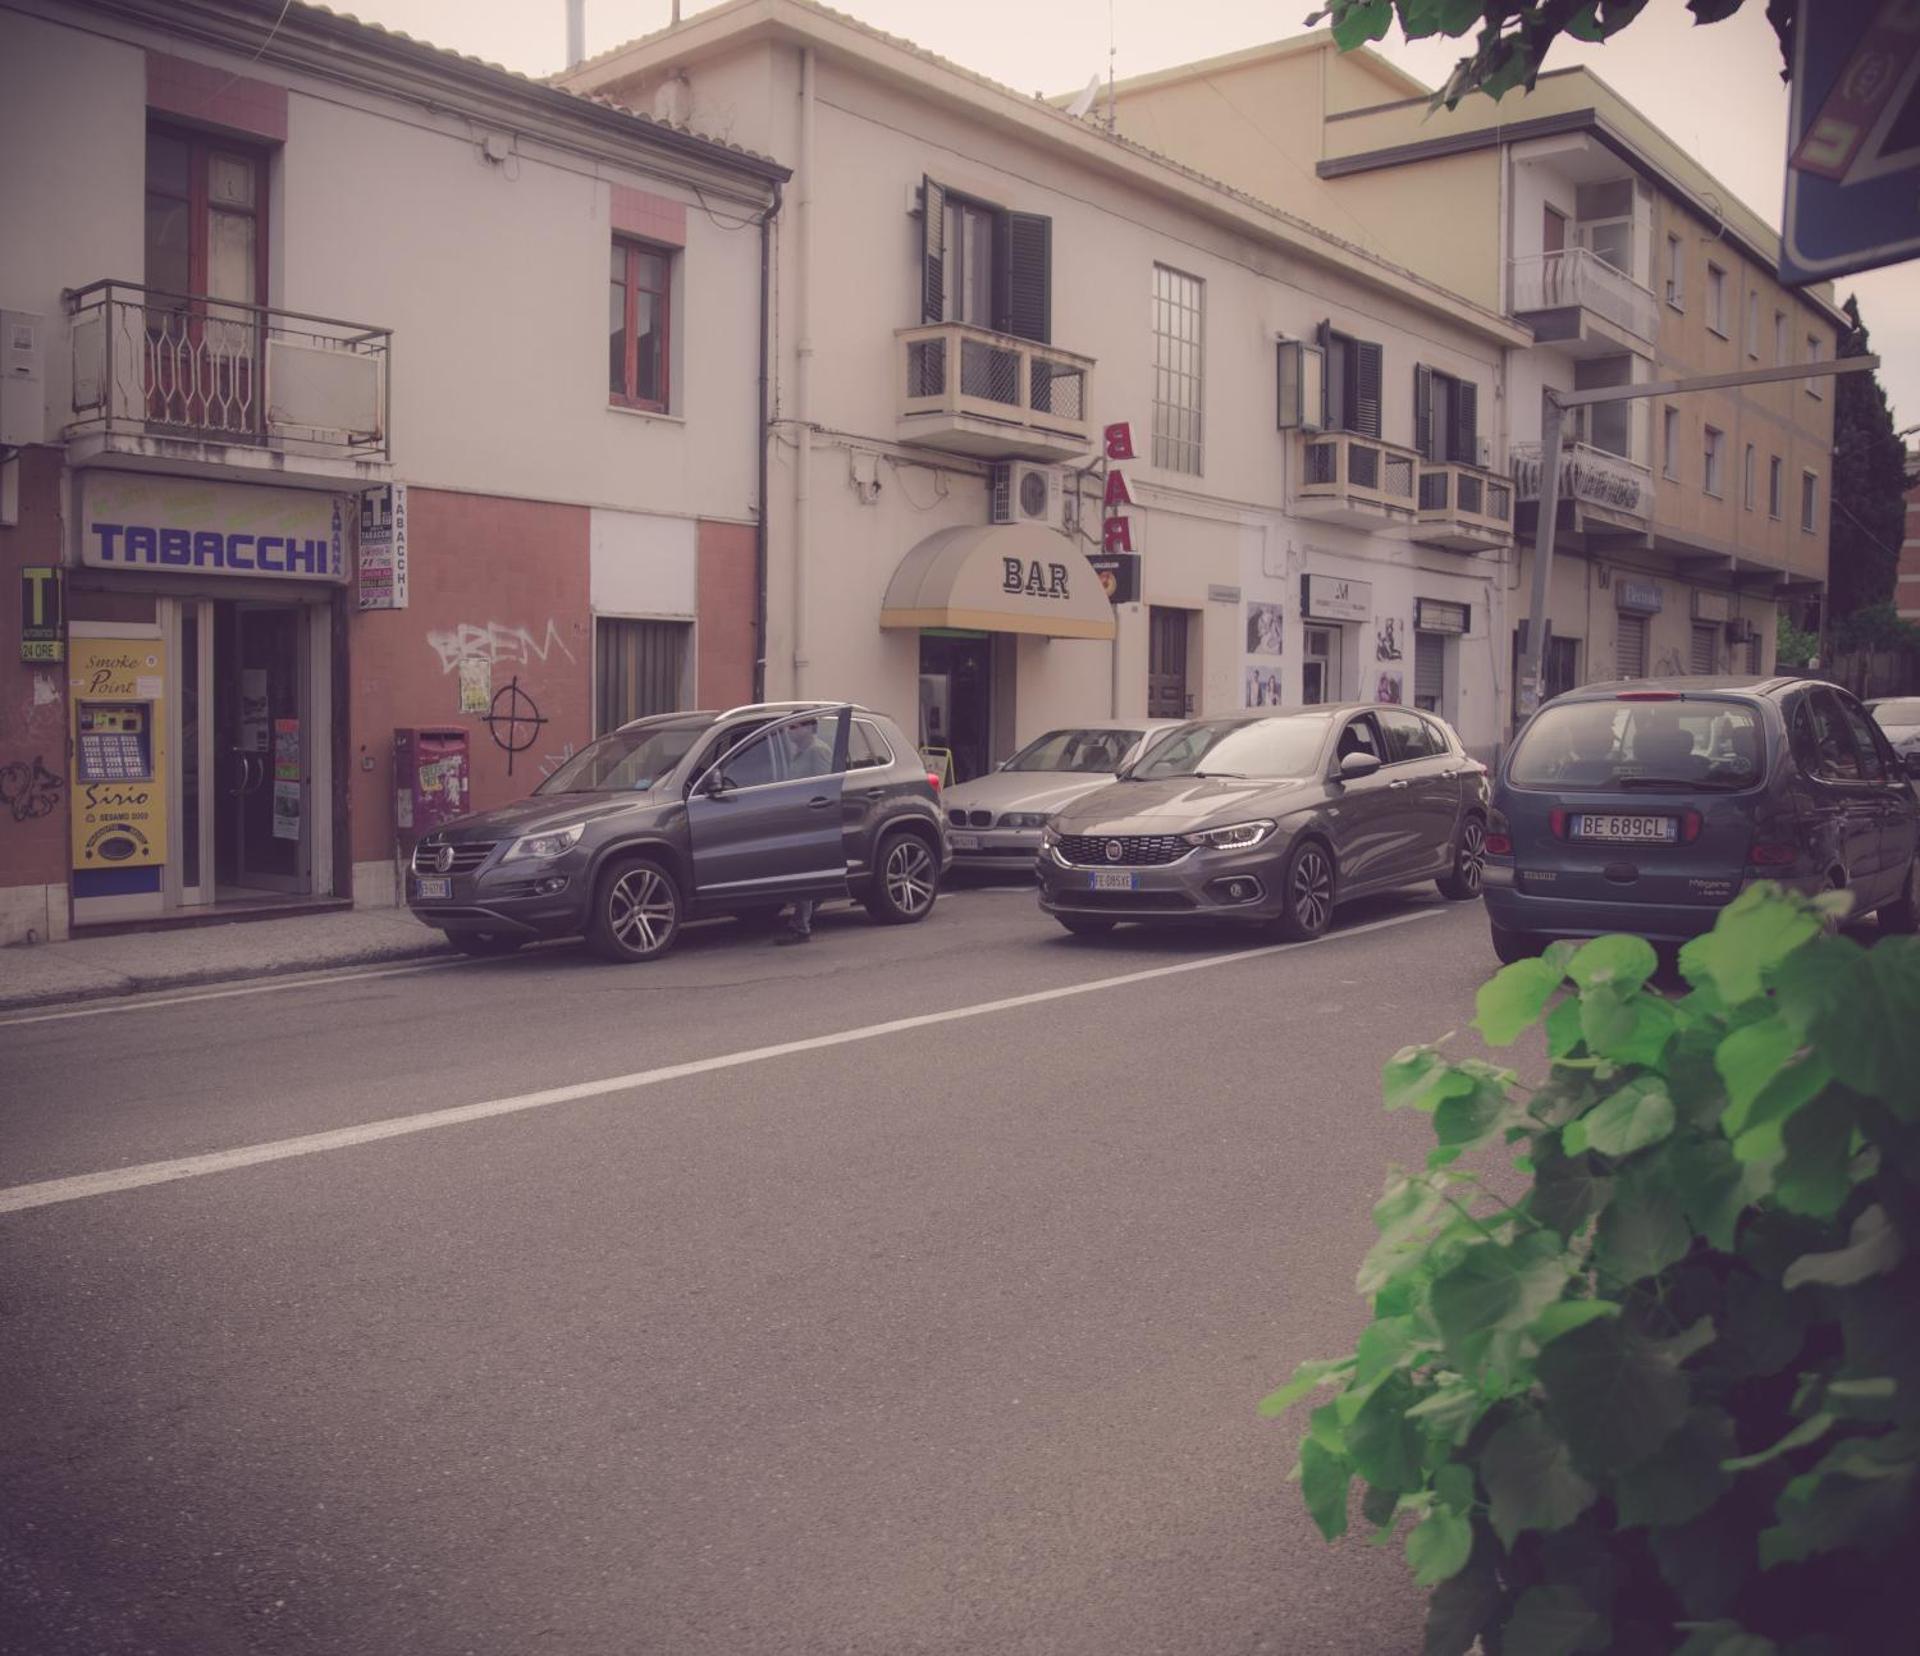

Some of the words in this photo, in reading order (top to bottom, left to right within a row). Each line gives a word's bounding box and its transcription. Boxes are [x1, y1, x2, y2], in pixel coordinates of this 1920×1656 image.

[91, 523, 328, 575] TABACCHI
[396, 490, 406, 597] TABACCHI
[1002, 556, 1070, 599] BAR
[23, 568, 52, 625] T
[86, 655, 140, 669] Smoke
[89, 669, 135, 693] Point
[85, 783, 149, 810] Sirio
[1583, 817, 1605, 835] BE
[1609, 818, 1665, 838] 689GL
